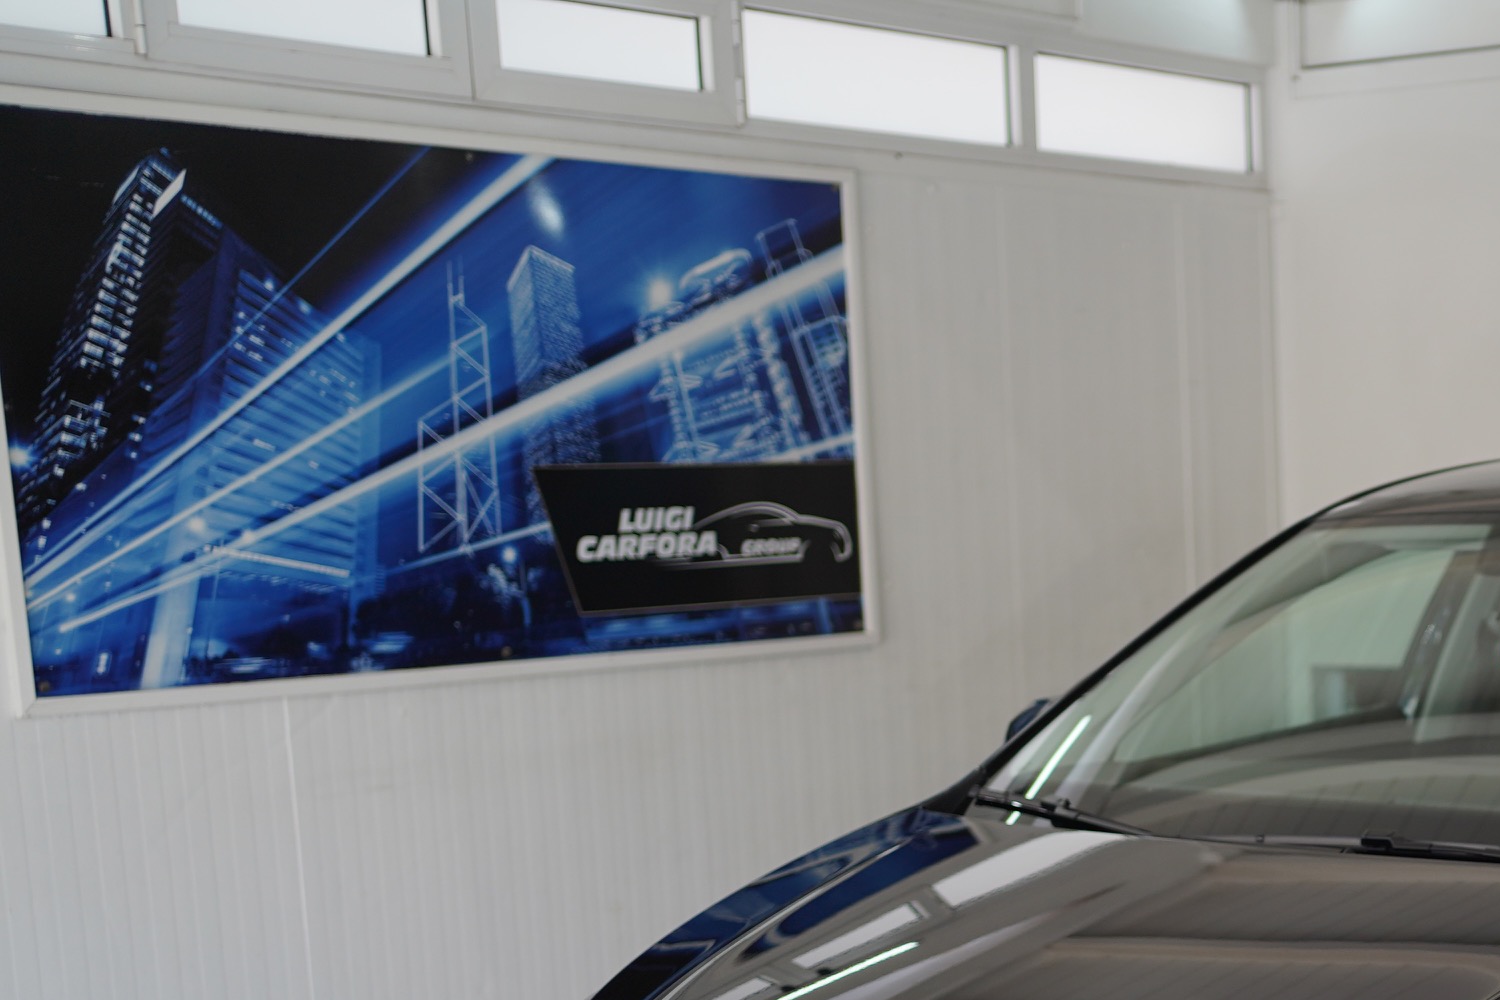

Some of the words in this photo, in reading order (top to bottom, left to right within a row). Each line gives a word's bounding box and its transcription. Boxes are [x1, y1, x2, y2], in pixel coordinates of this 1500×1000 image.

[619, 506, 695, 532] LUIGI
[577, 531, 717, 562] CARFORA
[740, 537, 802, 558] GROUP
